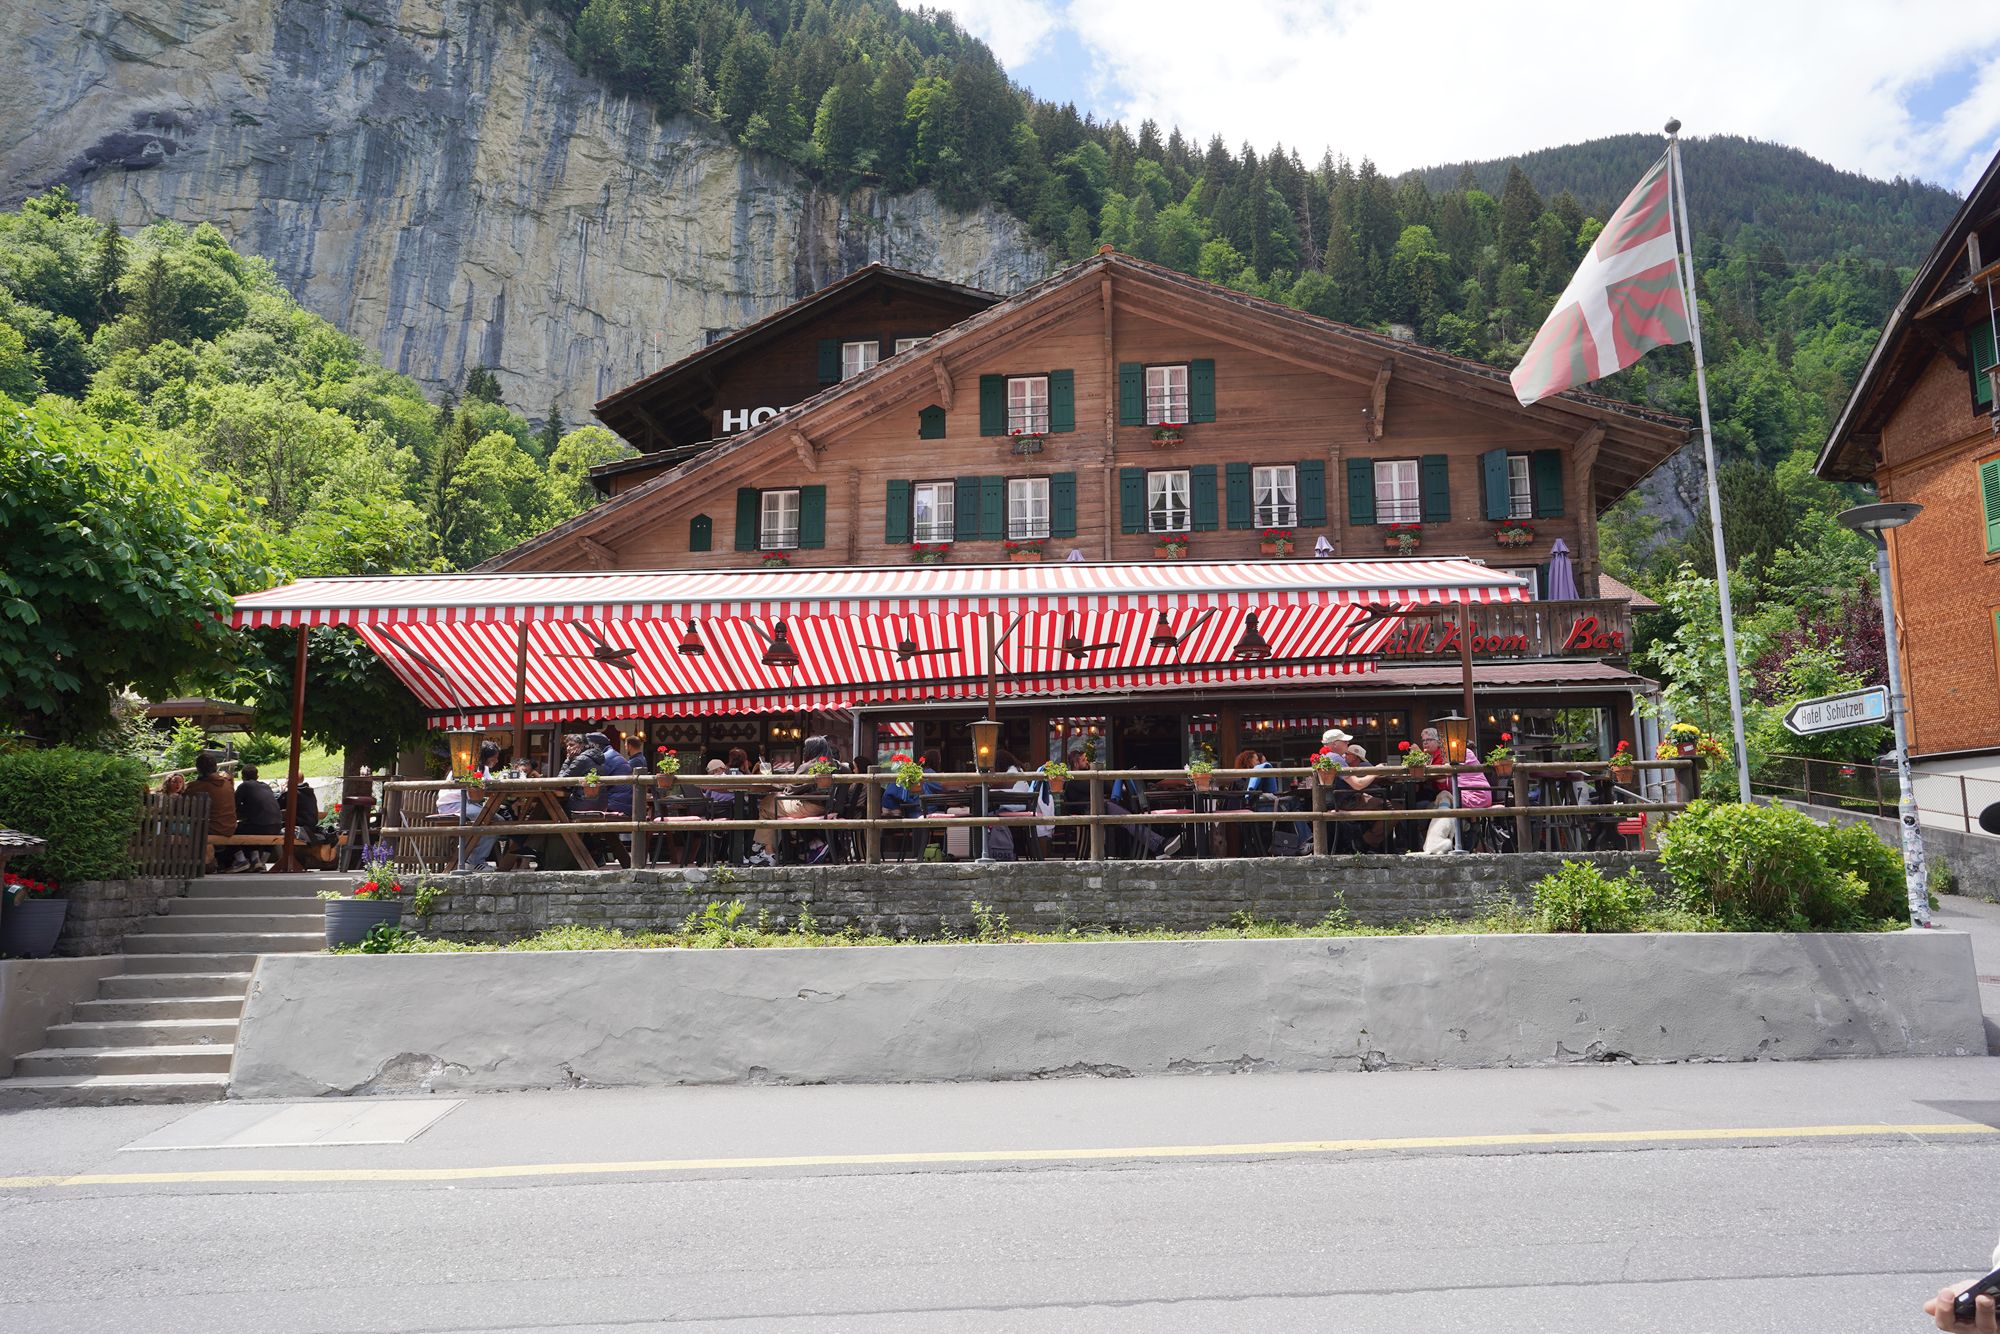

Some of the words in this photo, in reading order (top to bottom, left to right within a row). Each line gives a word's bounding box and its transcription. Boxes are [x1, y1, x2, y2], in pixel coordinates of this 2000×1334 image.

[722, 406, 791, 432] HO
[1380, 623, 1431, 654] rill
[1434, 620, 1529, 653] Room
[1561, 615, 1624, 650] Bar
[1801, 706, 1822, 726] Hotel
[1826, 702, 1864, 721] Schützen
